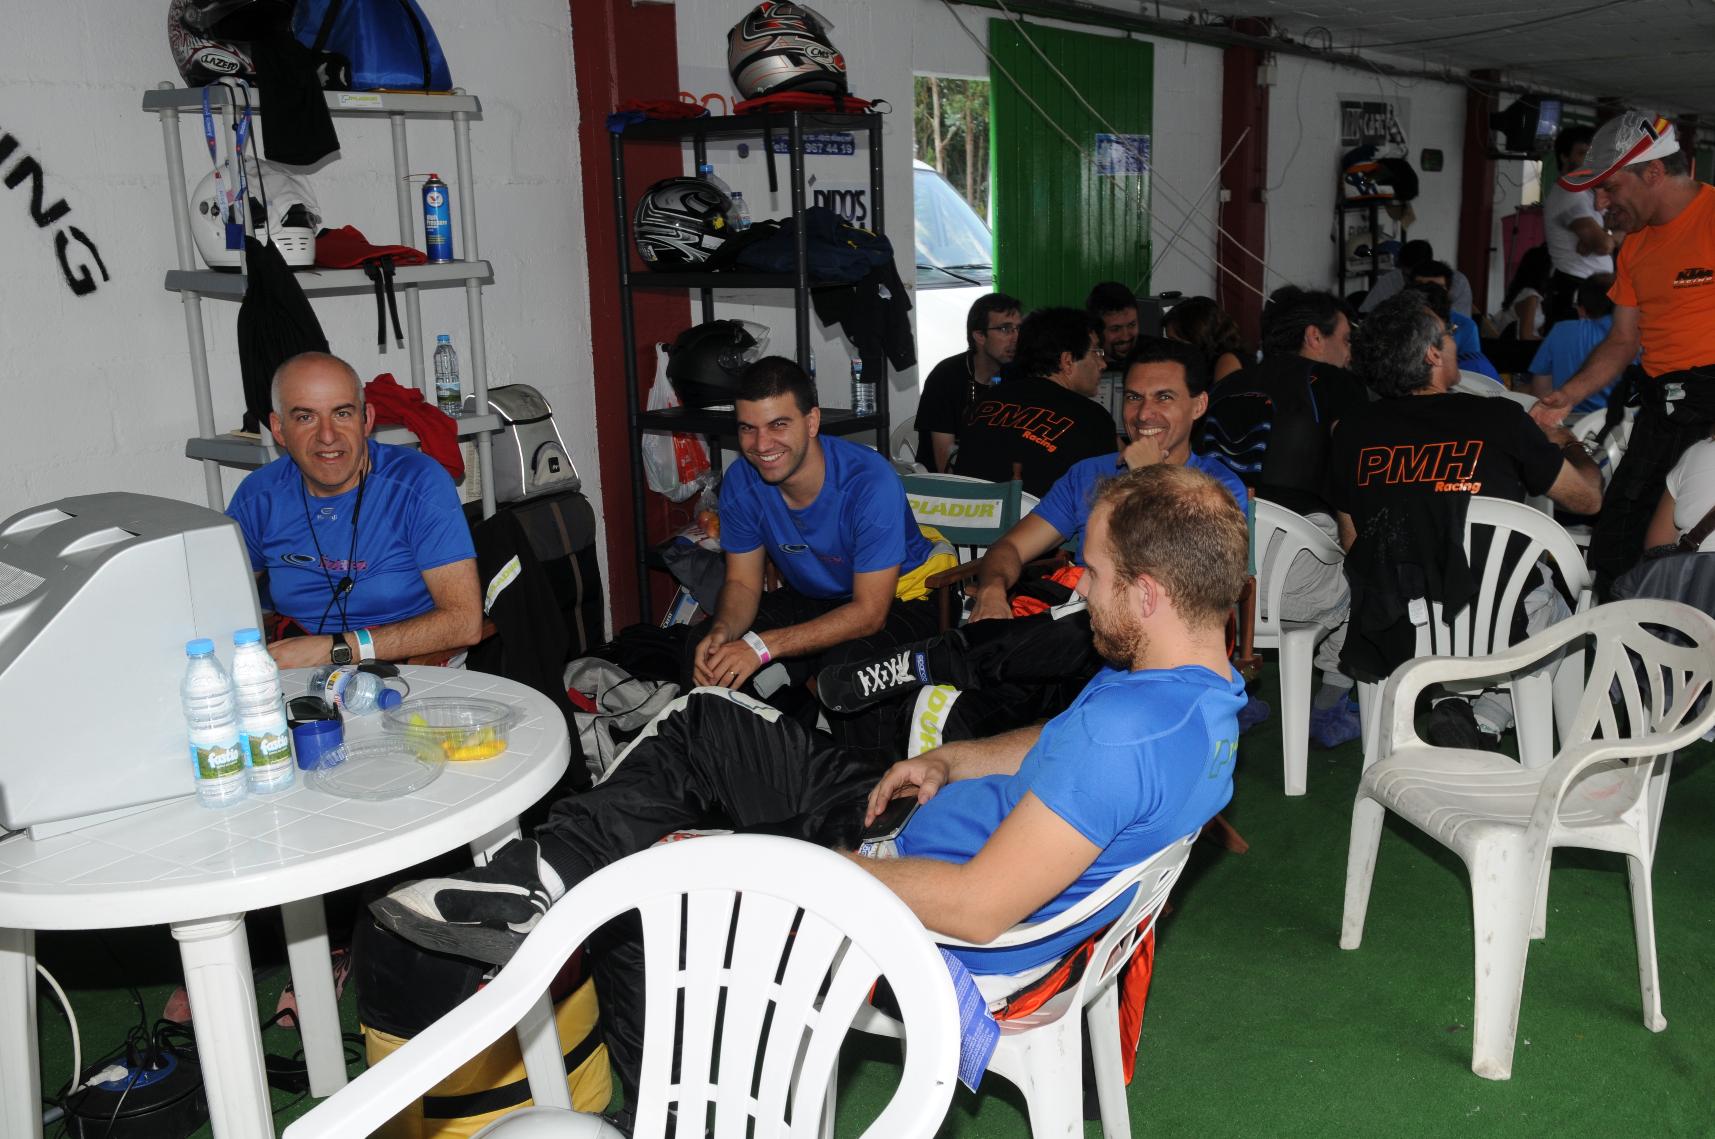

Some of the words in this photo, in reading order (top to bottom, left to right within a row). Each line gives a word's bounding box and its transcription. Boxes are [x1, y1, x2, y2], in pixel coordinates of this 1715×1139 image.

[203, 55, 237, 70] LAZER
[811, 48, 830, 59] CMS
[977, 400, 1075, 441] PMH
[1022, 430, 1057, 453] Racing
[1358, 440, 1483, 486] PMH
[1435, 481, 1482, 493] Racing
[920, 684, 956, 753] DUR
